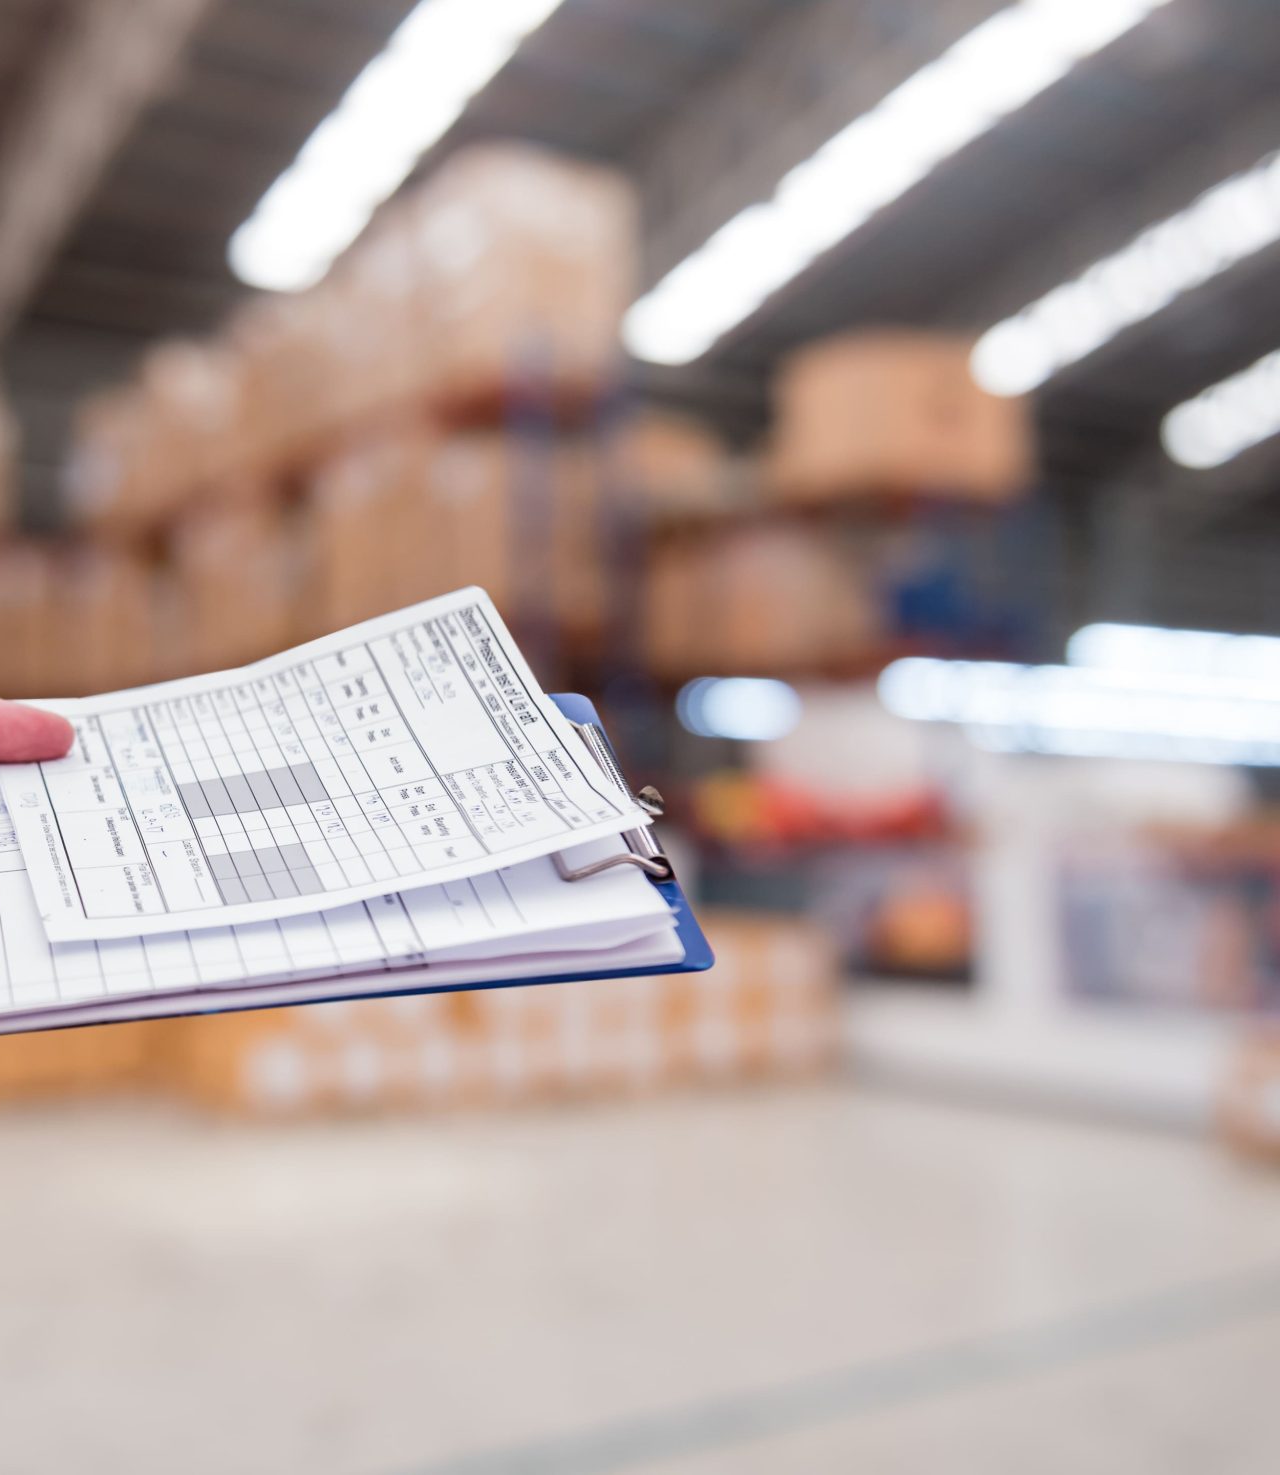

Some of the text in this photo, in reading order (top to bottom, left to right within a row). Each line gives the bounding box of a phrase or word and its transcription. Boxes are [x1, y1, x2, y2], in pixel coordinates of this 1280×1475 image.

[480, 637, 502, 673] Pressure
[495, 673, 512, 688] test
[509, 697, 528, 711] Life
[519, 711, 537, 725] raft
[498, 714, 514, 735] Production
[503, 760, 521, 779] Pressure
[548, 750, 567, 771] Registration
[434, 817, 449, 836] Boarding
